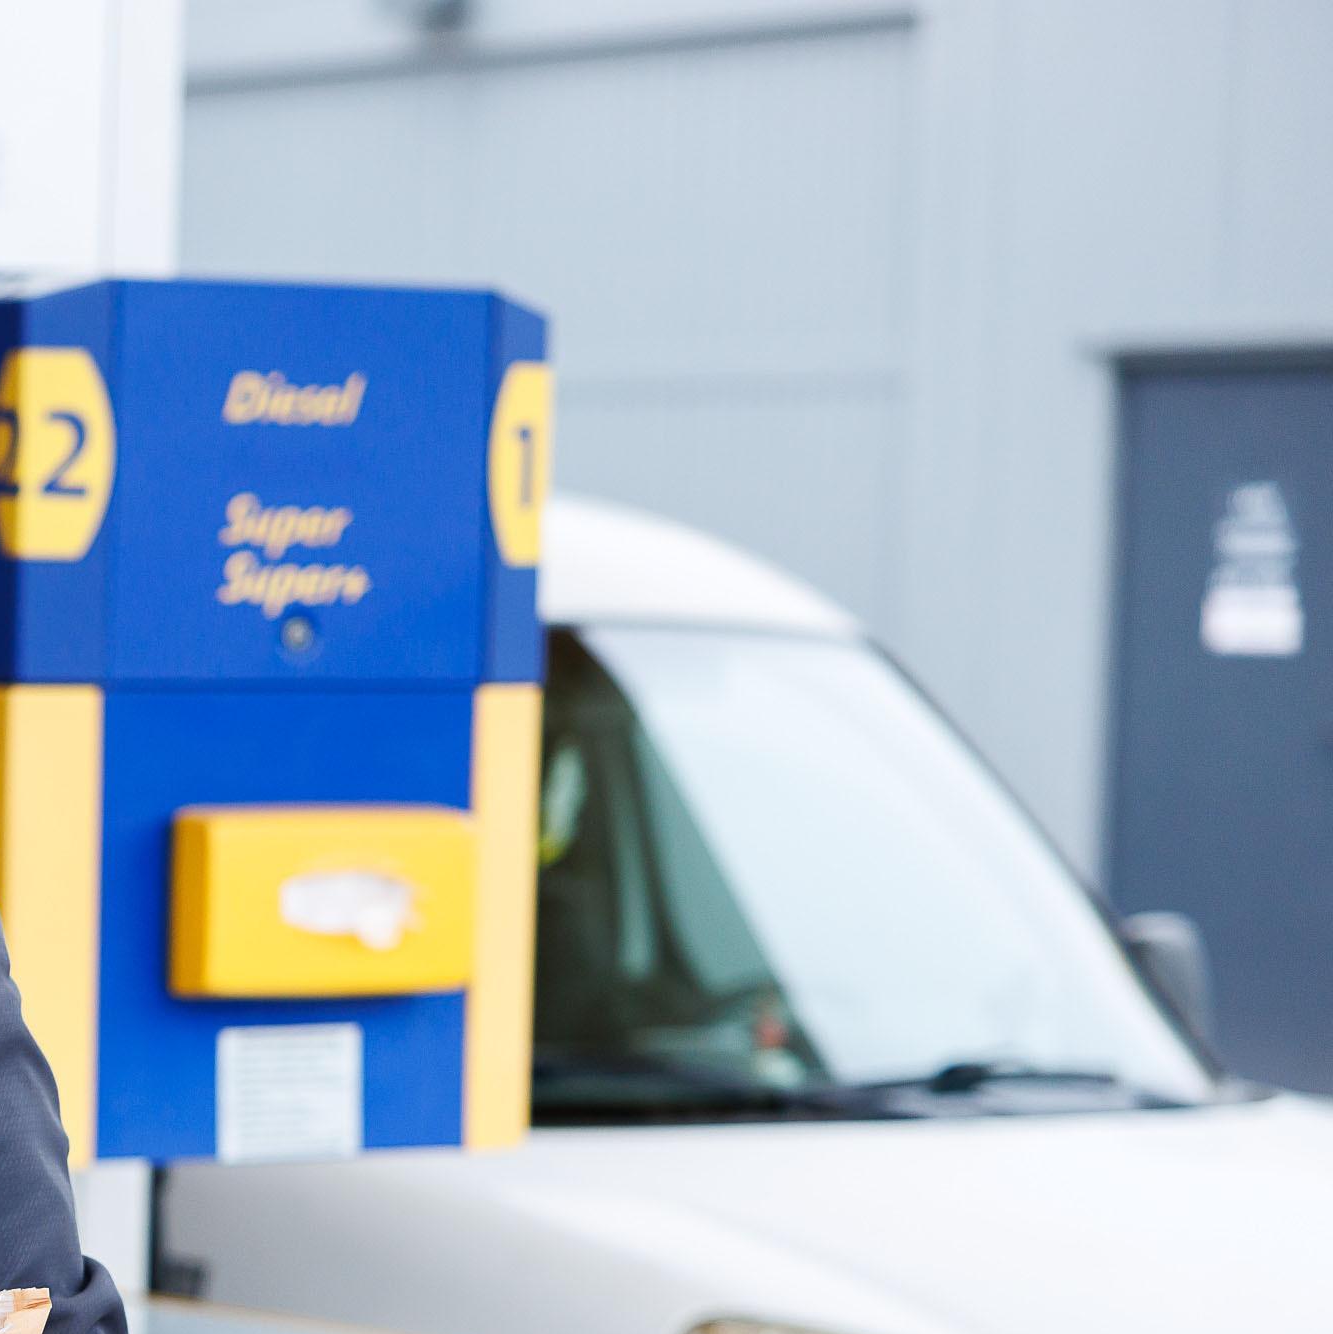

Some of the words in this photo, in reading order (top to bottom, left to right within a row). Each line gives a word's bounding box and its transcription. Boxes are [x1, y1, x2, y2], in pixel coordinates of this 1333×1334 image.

[223, 370, 368, 426] Diesel
[42, 410, 88, 496] 2
[511, 424, 533, 510] 1
[220, 494, 352, 559] Super
[217, 551, 370, 618] Super+
